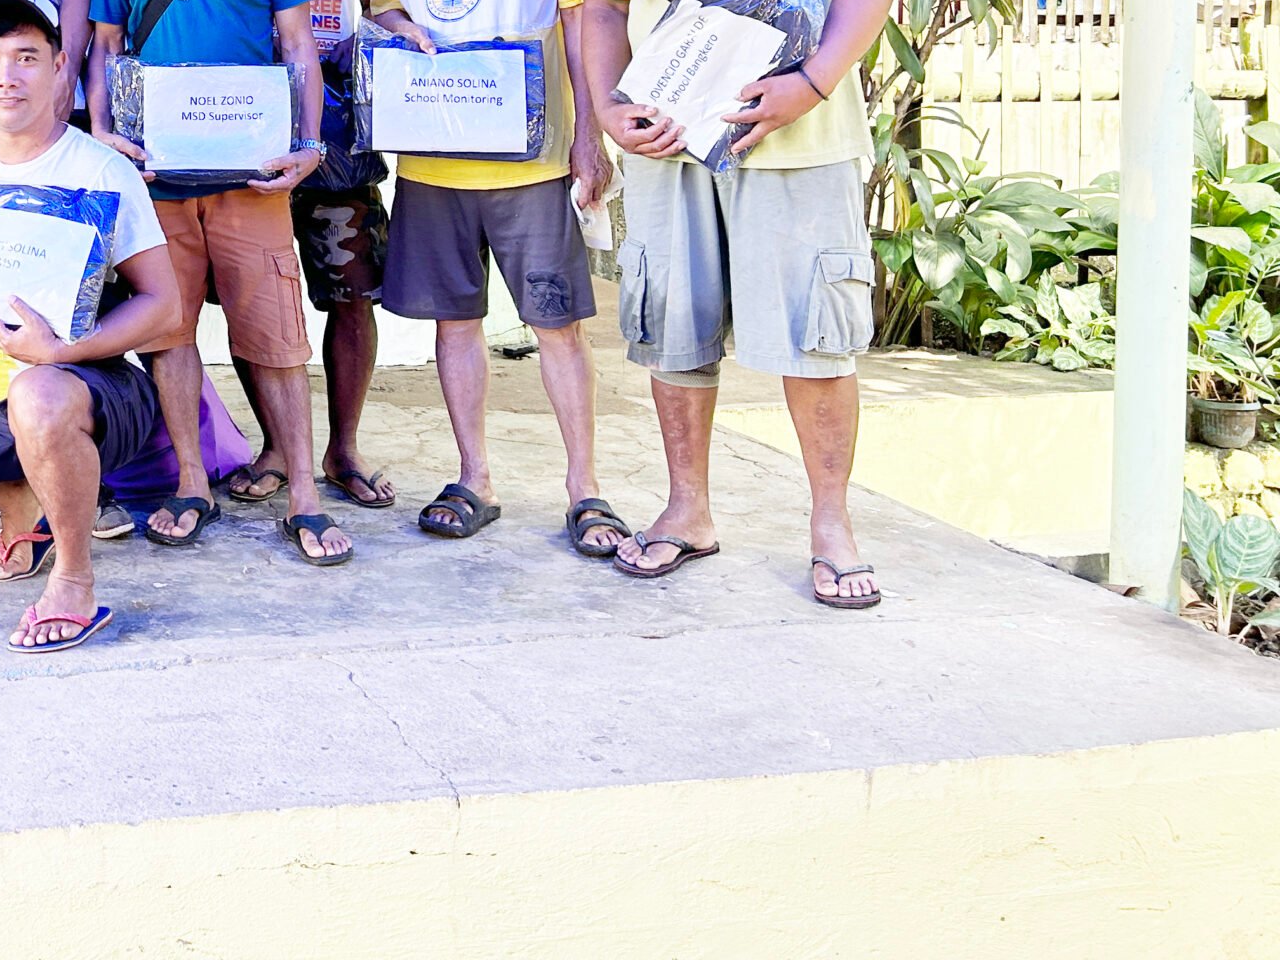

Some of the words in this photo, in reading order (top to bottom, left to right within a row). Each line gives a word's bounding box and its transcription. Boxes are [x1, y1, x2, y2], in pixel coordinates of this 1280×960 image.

[667, 75, 690, 105] School
[688, 34, 718, 76] Bangkero
[410, 77, 454, 88] ANIANO
[457, 78, 497, 88] SOLINA
[190, 96, 217, 105] NOEL
[220, 95, 253, 105] ZONIO
[405, 93, 439, 102] School
[443, 94, 503, 106] Monitoring
[181, 111, 206, 120] MSD
[209, 111, 263, 122] Supervisor
